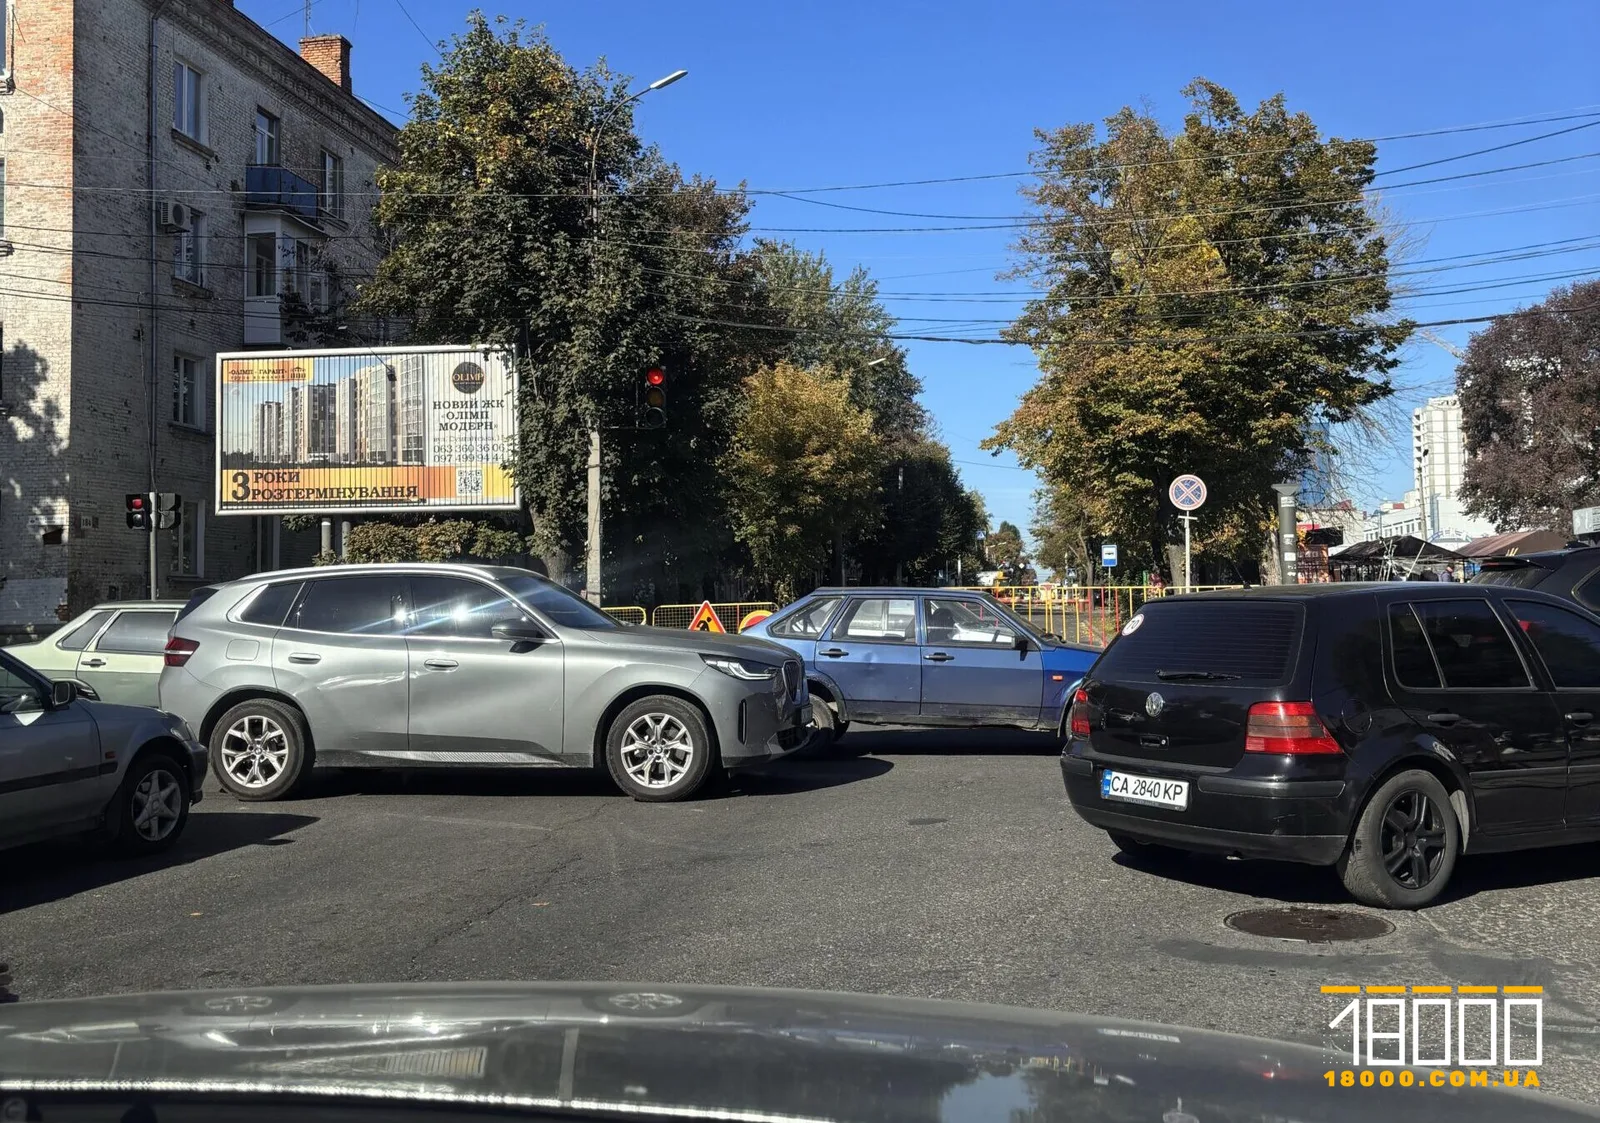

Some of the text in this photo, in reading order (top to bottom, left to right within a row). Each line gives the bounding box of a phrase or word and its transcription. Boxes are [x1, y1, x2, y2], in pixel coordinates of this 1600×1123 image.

[452, 373, 484, 382] OLIMP
[433, 398, 505, 410] НОВИЙ ЖК
[232, 471, 300, 501] 3 РОКИ
[252, 486, 418, 500] РОЗТЕРМІНУВАННЯ
[1111, 776, 1128, 794] CA
[1132, 779, 1160, 799] 2840
[1163, 783, 1183, 801] KP
